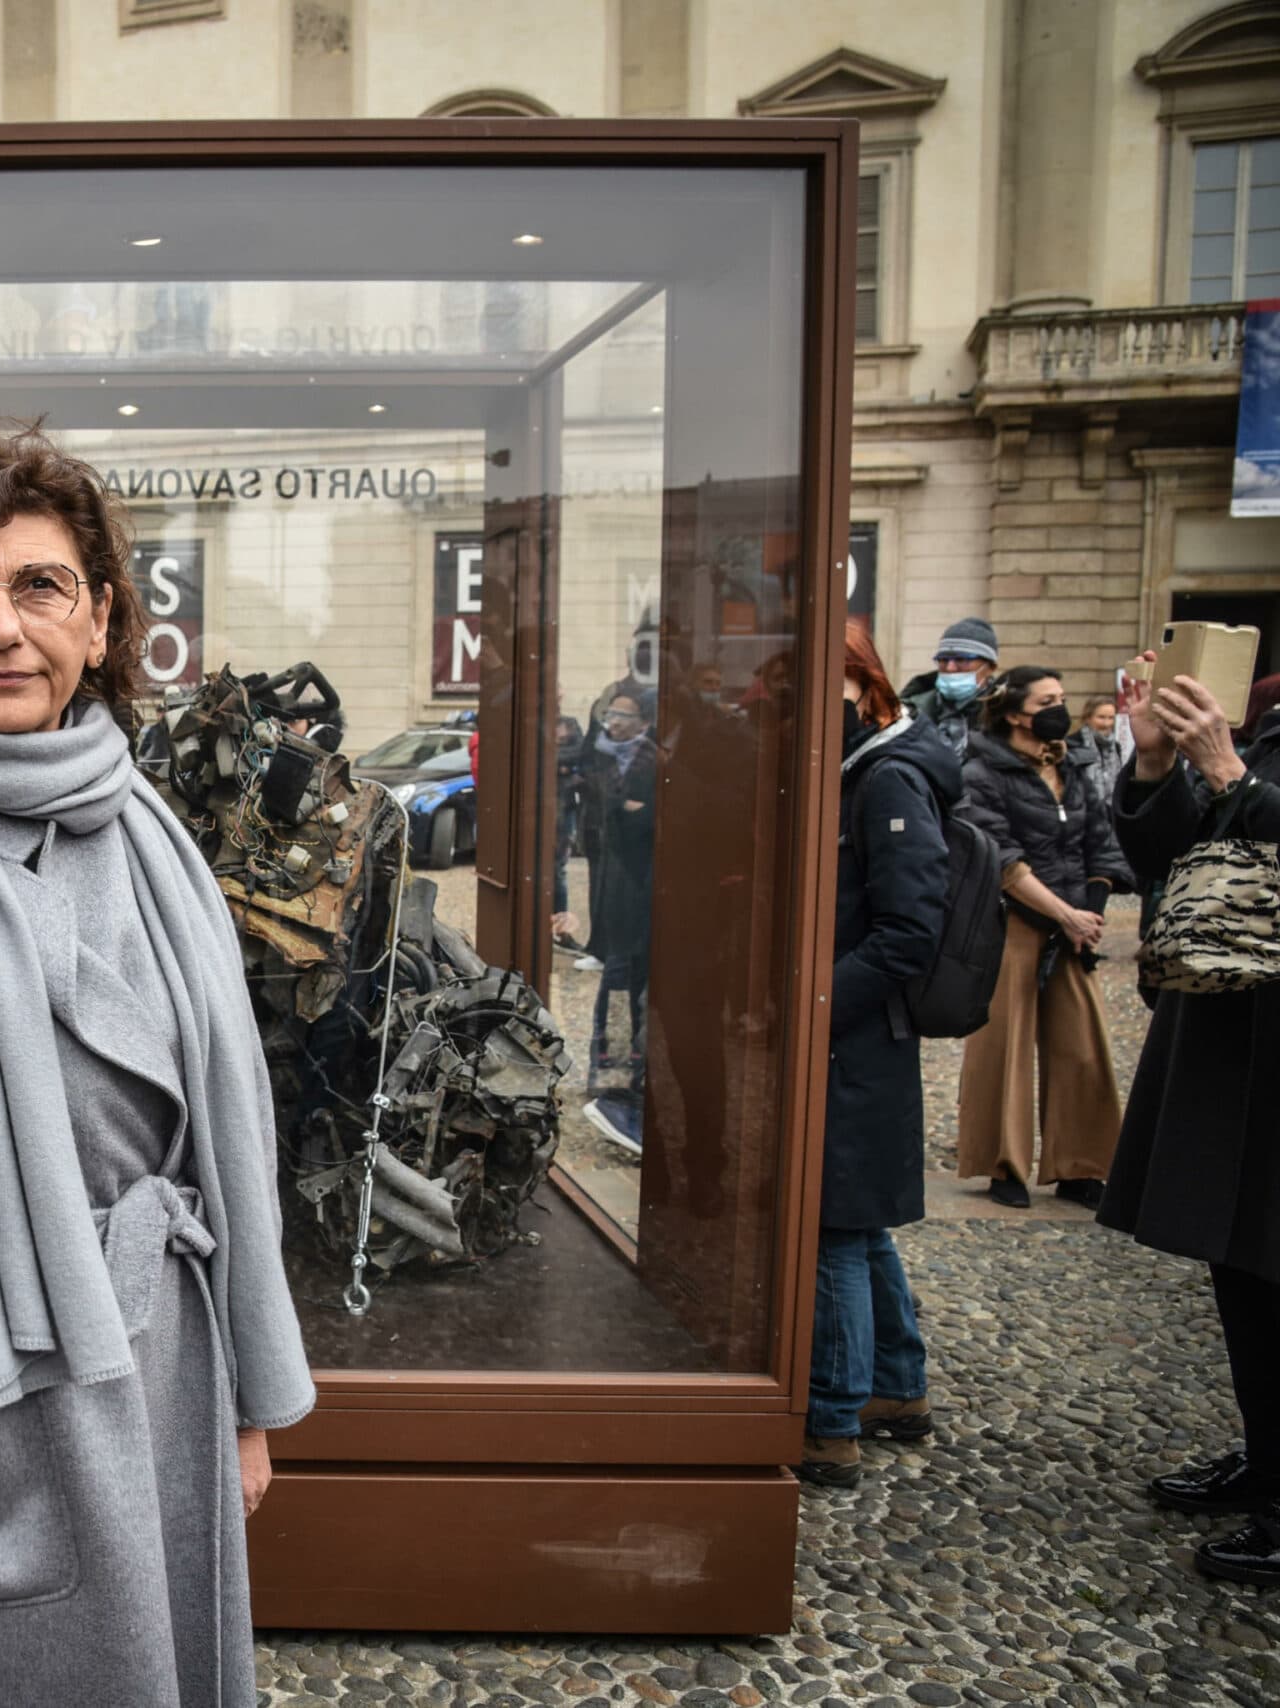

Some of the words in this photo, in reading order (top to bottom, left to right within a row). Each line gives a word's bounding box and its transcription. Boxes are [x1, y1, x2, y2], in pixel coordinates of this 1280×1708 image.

[150, 557, 180, 616] S
[456, 548, 484, 613] E
[142, 622, 189, 682] O
